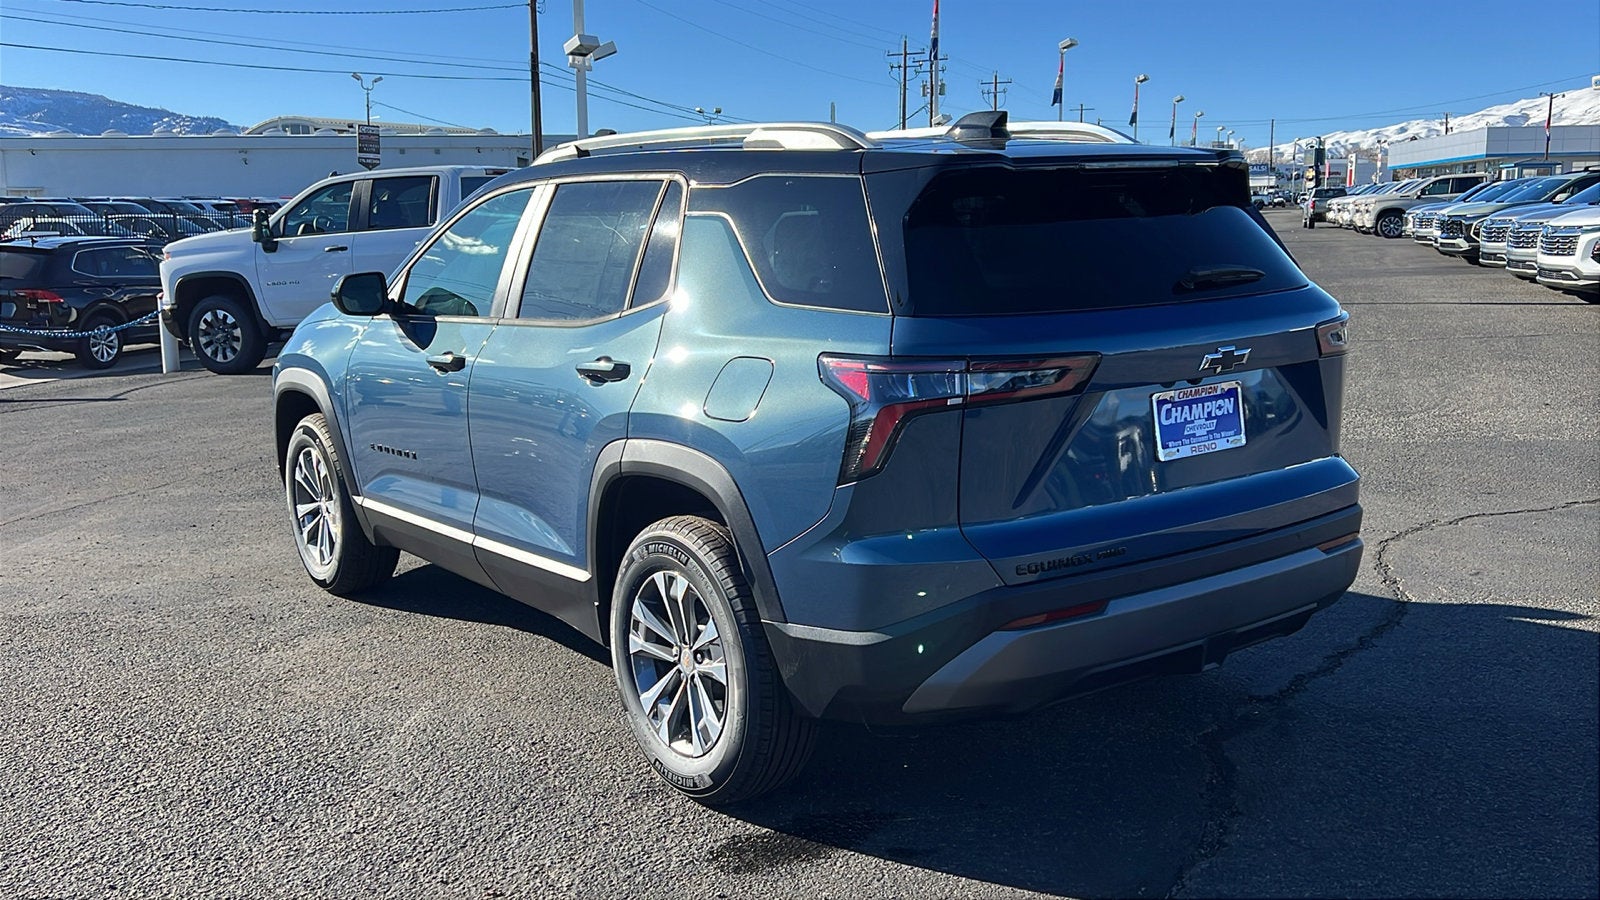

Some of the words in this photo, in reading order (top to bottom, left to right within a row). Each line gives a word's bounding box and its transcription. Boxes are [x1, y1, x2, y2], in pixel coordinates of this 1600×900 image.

[1178, 386, 1219, 399] CHAMPION
[1161, 398, 1234, 426] CHAMPION
[1186, 421, 1215, 432] CHEVROLET
[1190, 442, 1217, 454] RENO
[648, 544, 688, 564] MICHELIN
[1015, 553, 1094, 576] EQUINOX
[654, 760, 694, 788] MICHELIN
